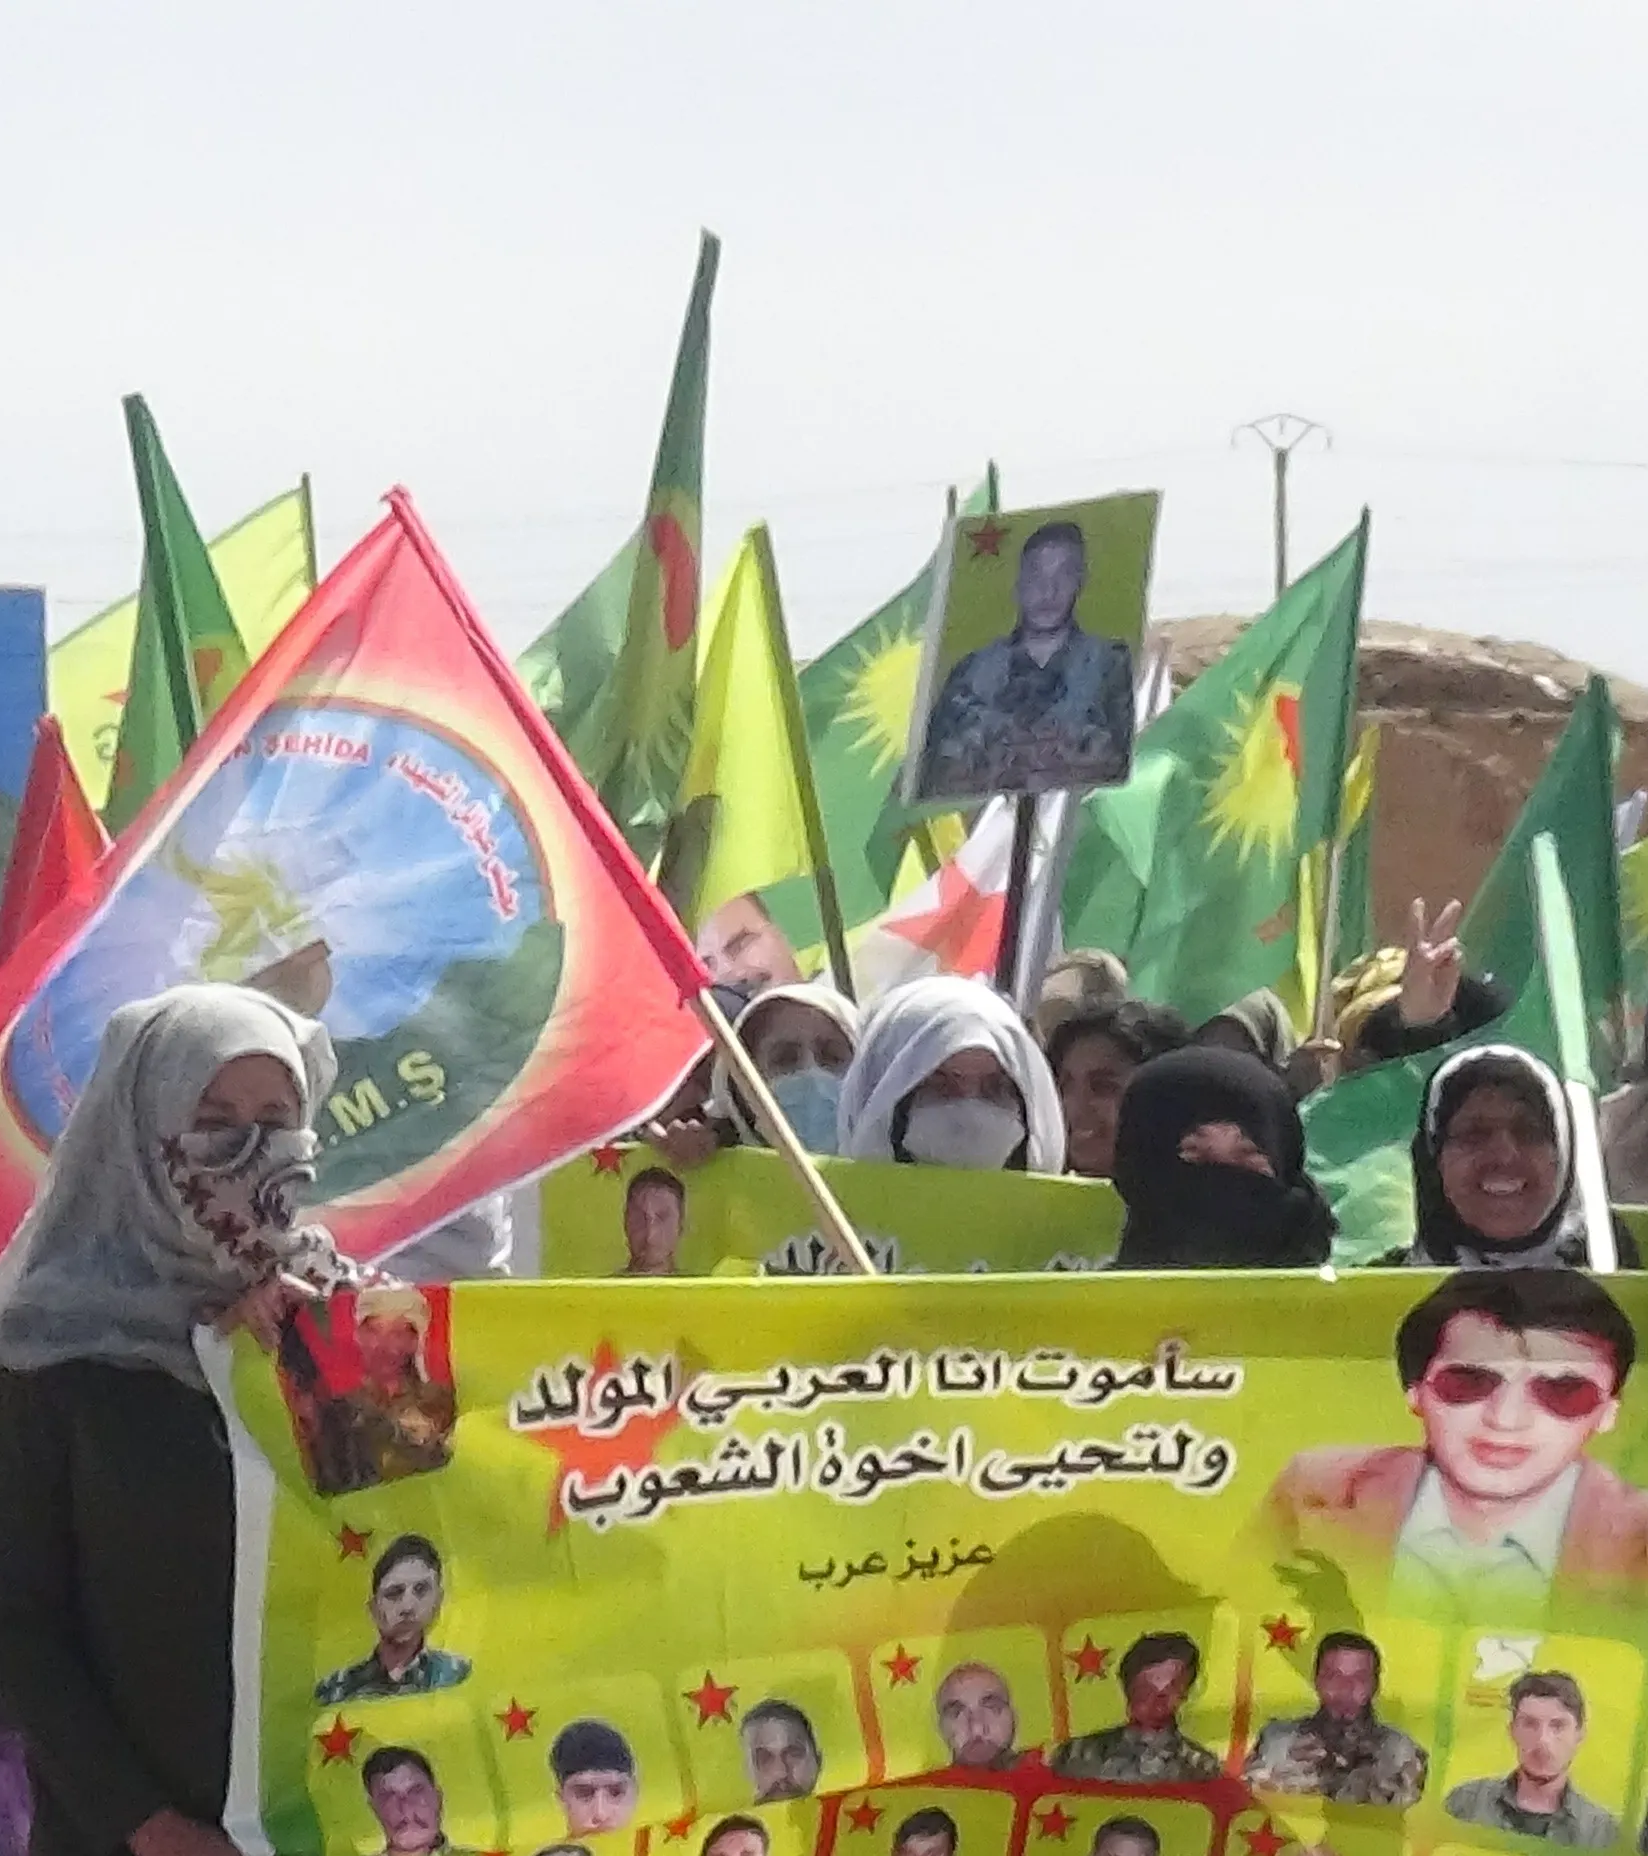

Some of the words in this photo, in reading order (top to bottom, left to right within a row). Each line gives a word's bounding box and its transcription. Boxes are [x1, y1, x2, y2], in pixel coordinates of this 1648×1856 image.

[684, 1352, 914, 1424] العربي
[935, 1350, 1002, 1392] انا
[1016, 1335, 1239, 1404] سأموت
[566, 1434, 804, 1528] الشعوب
[797, 1551, 888, 1592] عرب
[892, 1536, 996, 1582] عزيز
